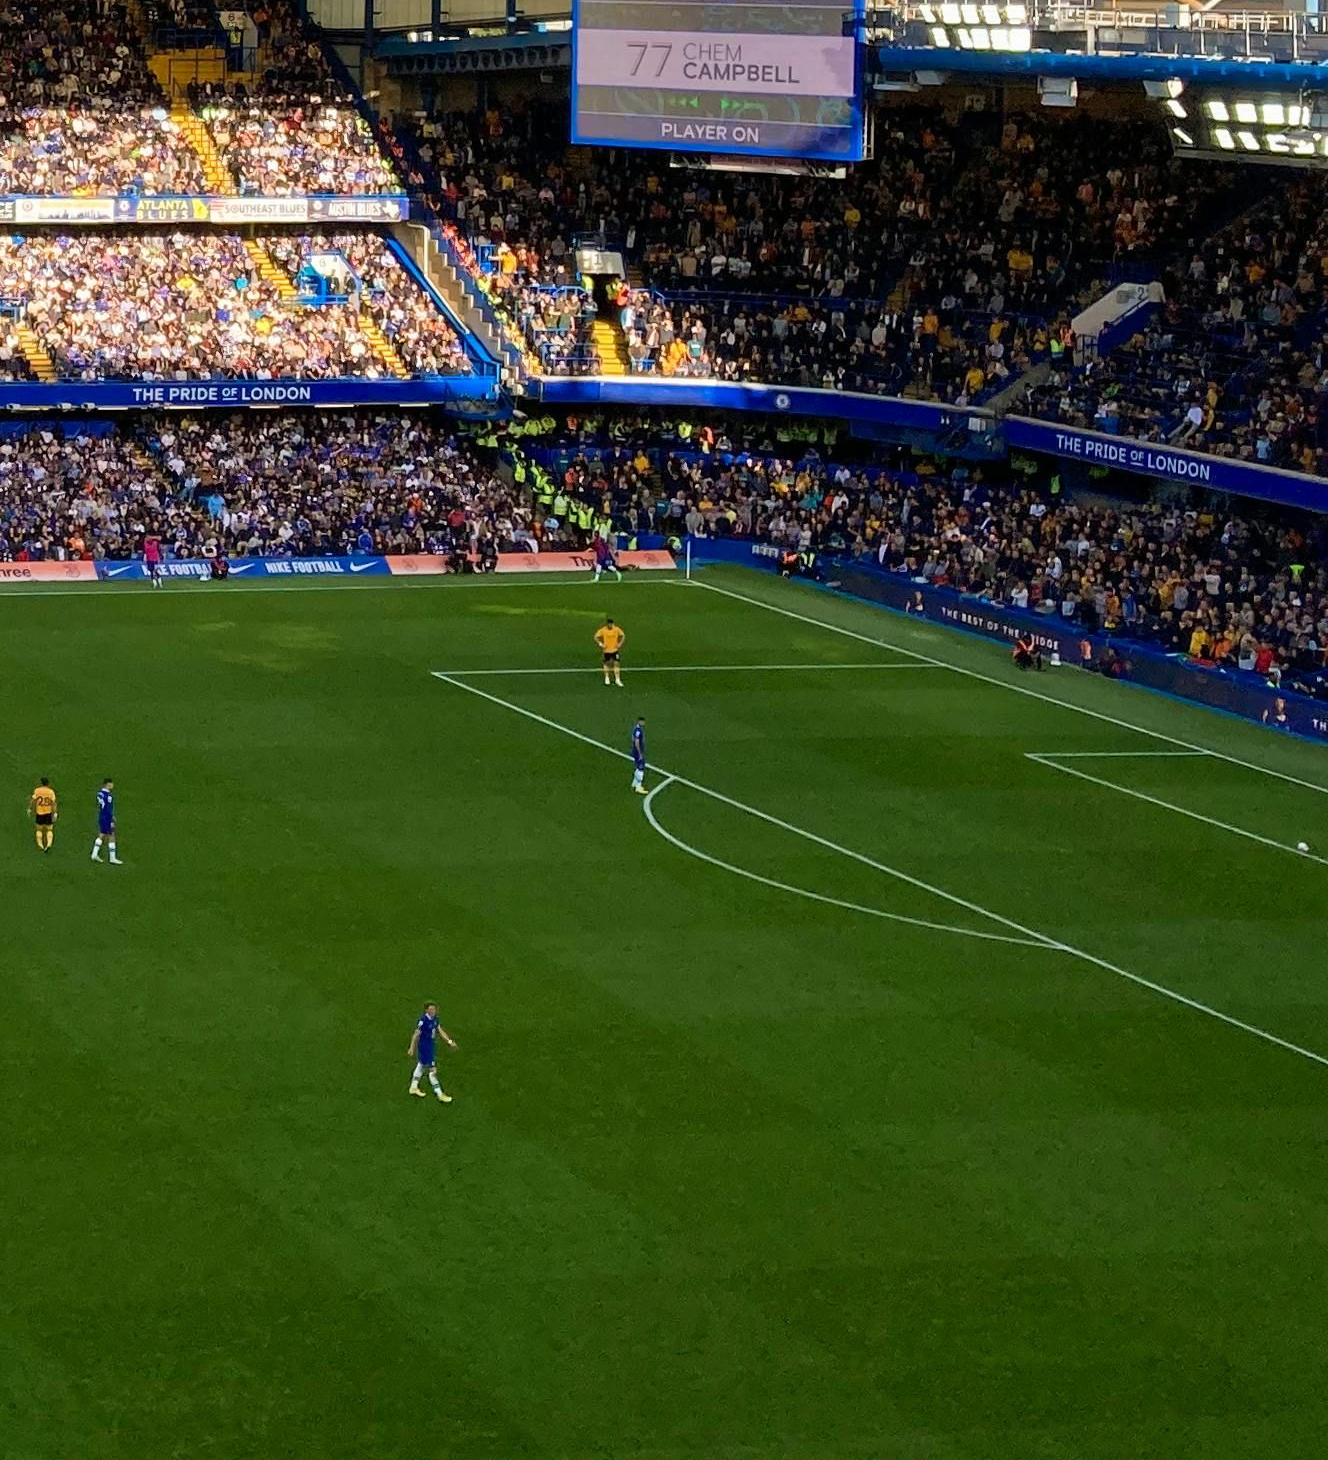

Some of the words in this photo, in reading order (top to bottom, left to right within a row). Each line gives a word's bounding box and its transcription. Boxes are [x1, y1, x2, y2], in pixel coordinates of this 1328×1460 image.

[627, 41, 673, 77] 77
[683, 42, 742, 62] CHEM
[683, 62, 800, 84] CAMPBELL
[661, 123, 727, 141] PLAYER
[732, 127, 759, 143] ON
[137, 200, 188, 210] ATLANTA
[225, 203, 278, 214] SOUTHEAST
[279, 202, 306, 213] BLUES
[356, 202, 382, 217] BLUES
[137, 210, 189, 220] BLUES
[133, 388, 164, 402] THE
[169, 388, 218, 401] PRIDE
[222, 388, 238, 398] OF
[241, 387, 311, 400] LONDON
[1056, 434, 1082, 453] THE
[1085, 440, 1127, 463] PRIDE
[1130, 450, 1145, 462] OF
[1147, 453, 1211, 481] LONDON
[169, 562, 212, 575] FOOTBA
[265, 561, 292, 573] NIKE
[293, 560, 344, 573] FOOTBALL
[961, 613, 984, 627] BEST
[987, 621, 999, 631] OF
[1003, 625, 1020, 638] THE
